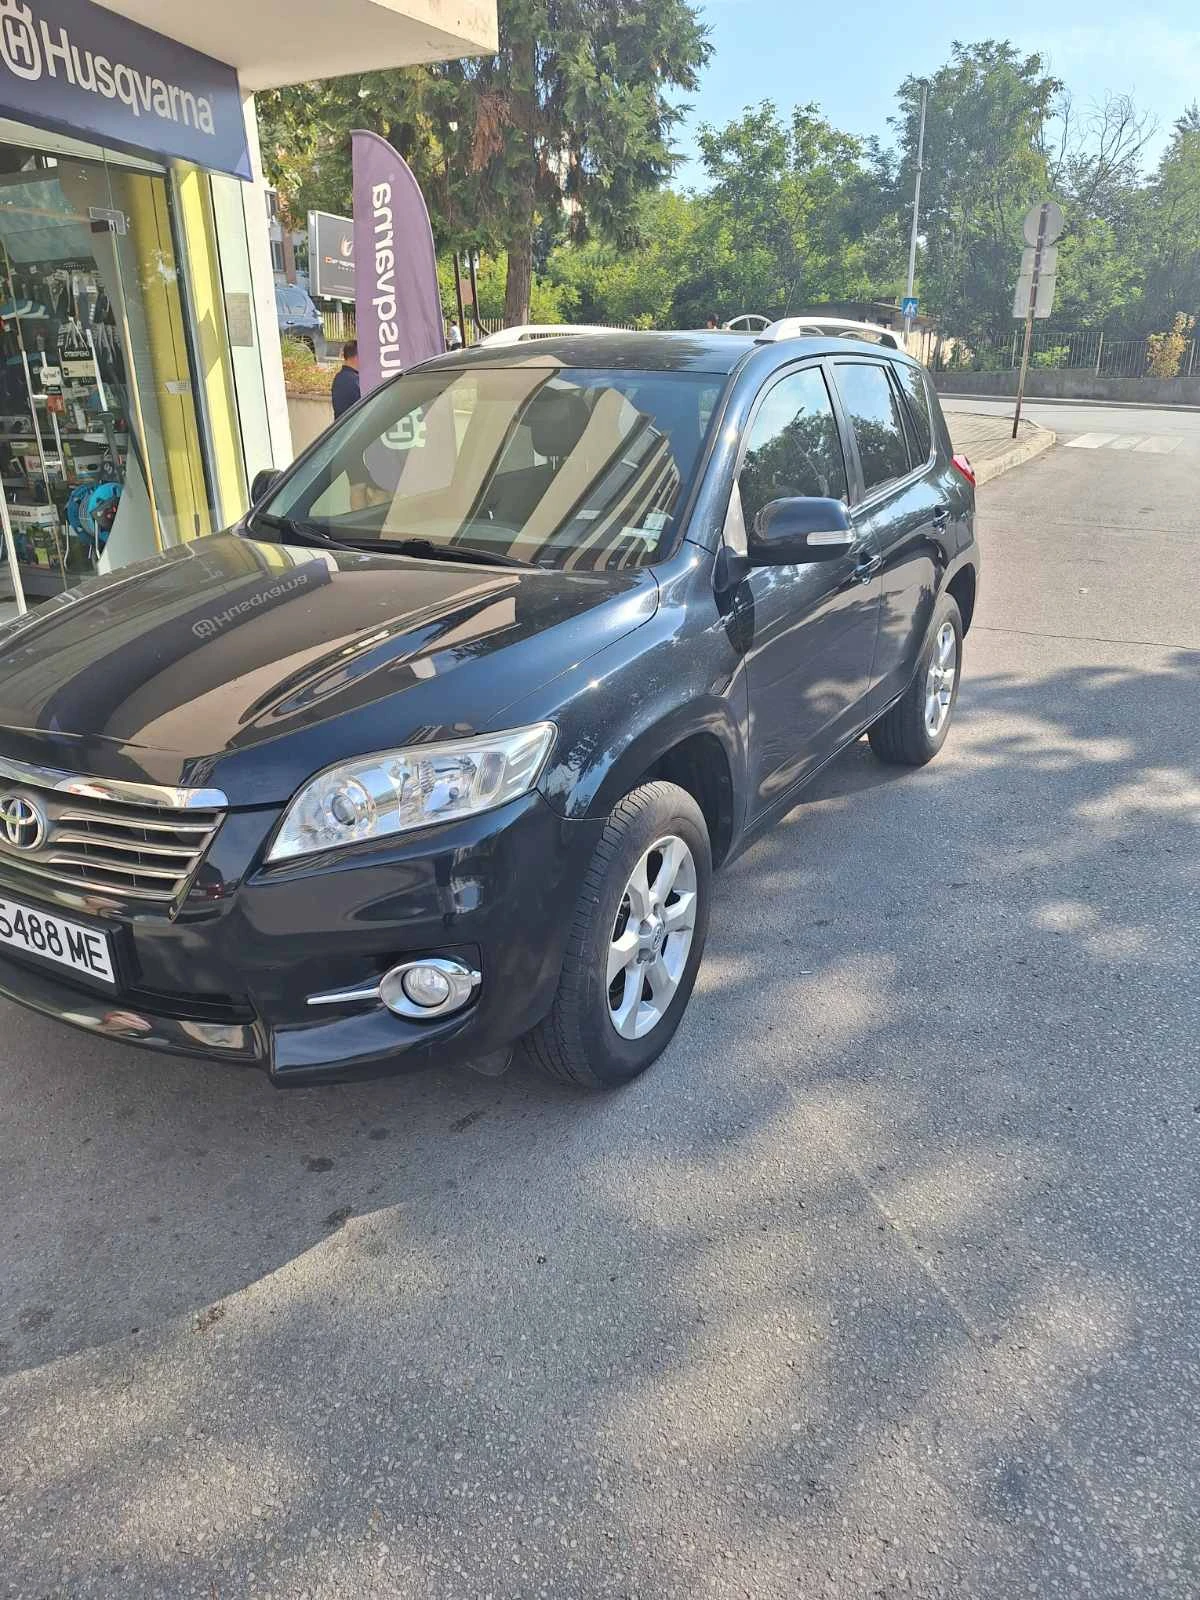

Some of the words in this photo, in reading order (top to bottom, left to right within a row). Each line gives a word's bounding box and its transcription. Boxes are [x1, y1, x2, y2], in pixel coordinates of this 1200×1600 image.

[39, 19, 216, 136] Husqvarna
[0, 902, 64, 957] 5488
[64, 926, 109, 975] ME
